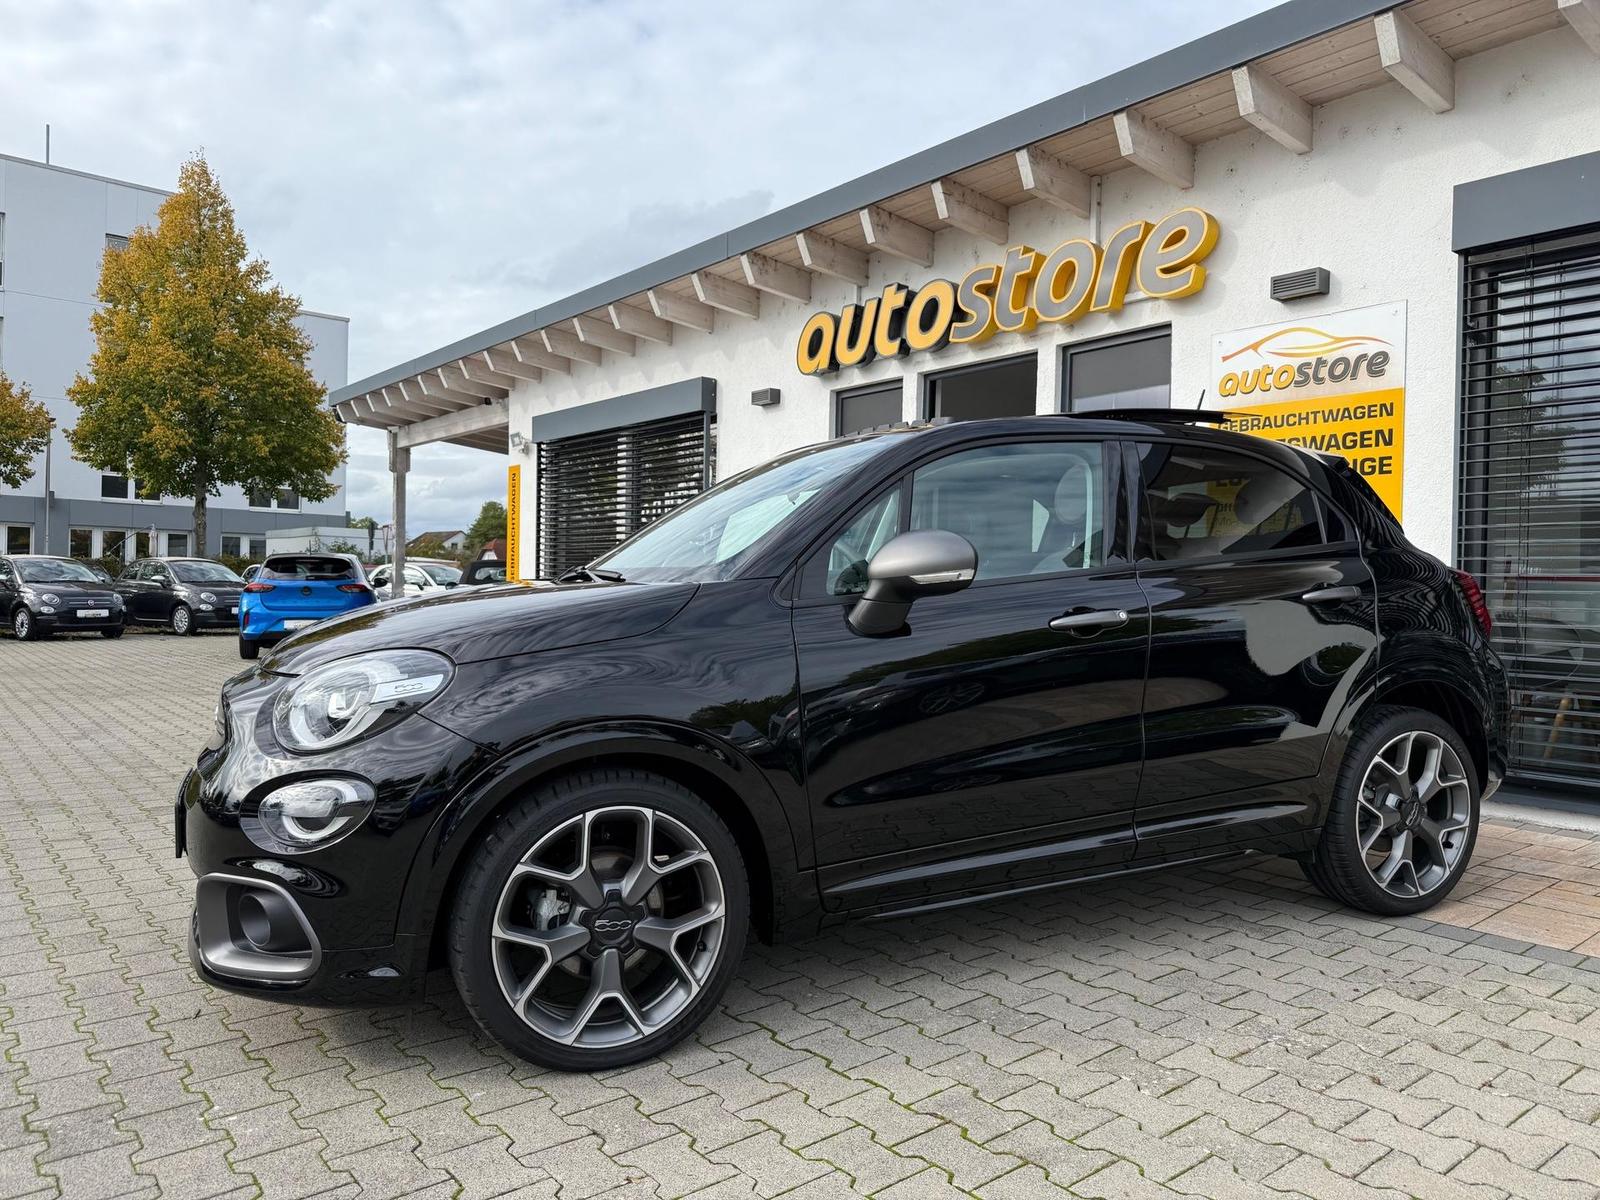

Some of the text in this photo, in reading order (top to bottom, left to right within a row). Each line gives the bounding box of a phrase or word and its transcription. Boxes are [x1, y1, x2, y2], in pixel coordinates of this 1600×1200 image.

[797, 207, 1218, 377] autostore
[1218, 350, 1391, 398] autostore
[1275, 428, 1394, 452] SWAGEN
[594, 919, 632, 932] 500
